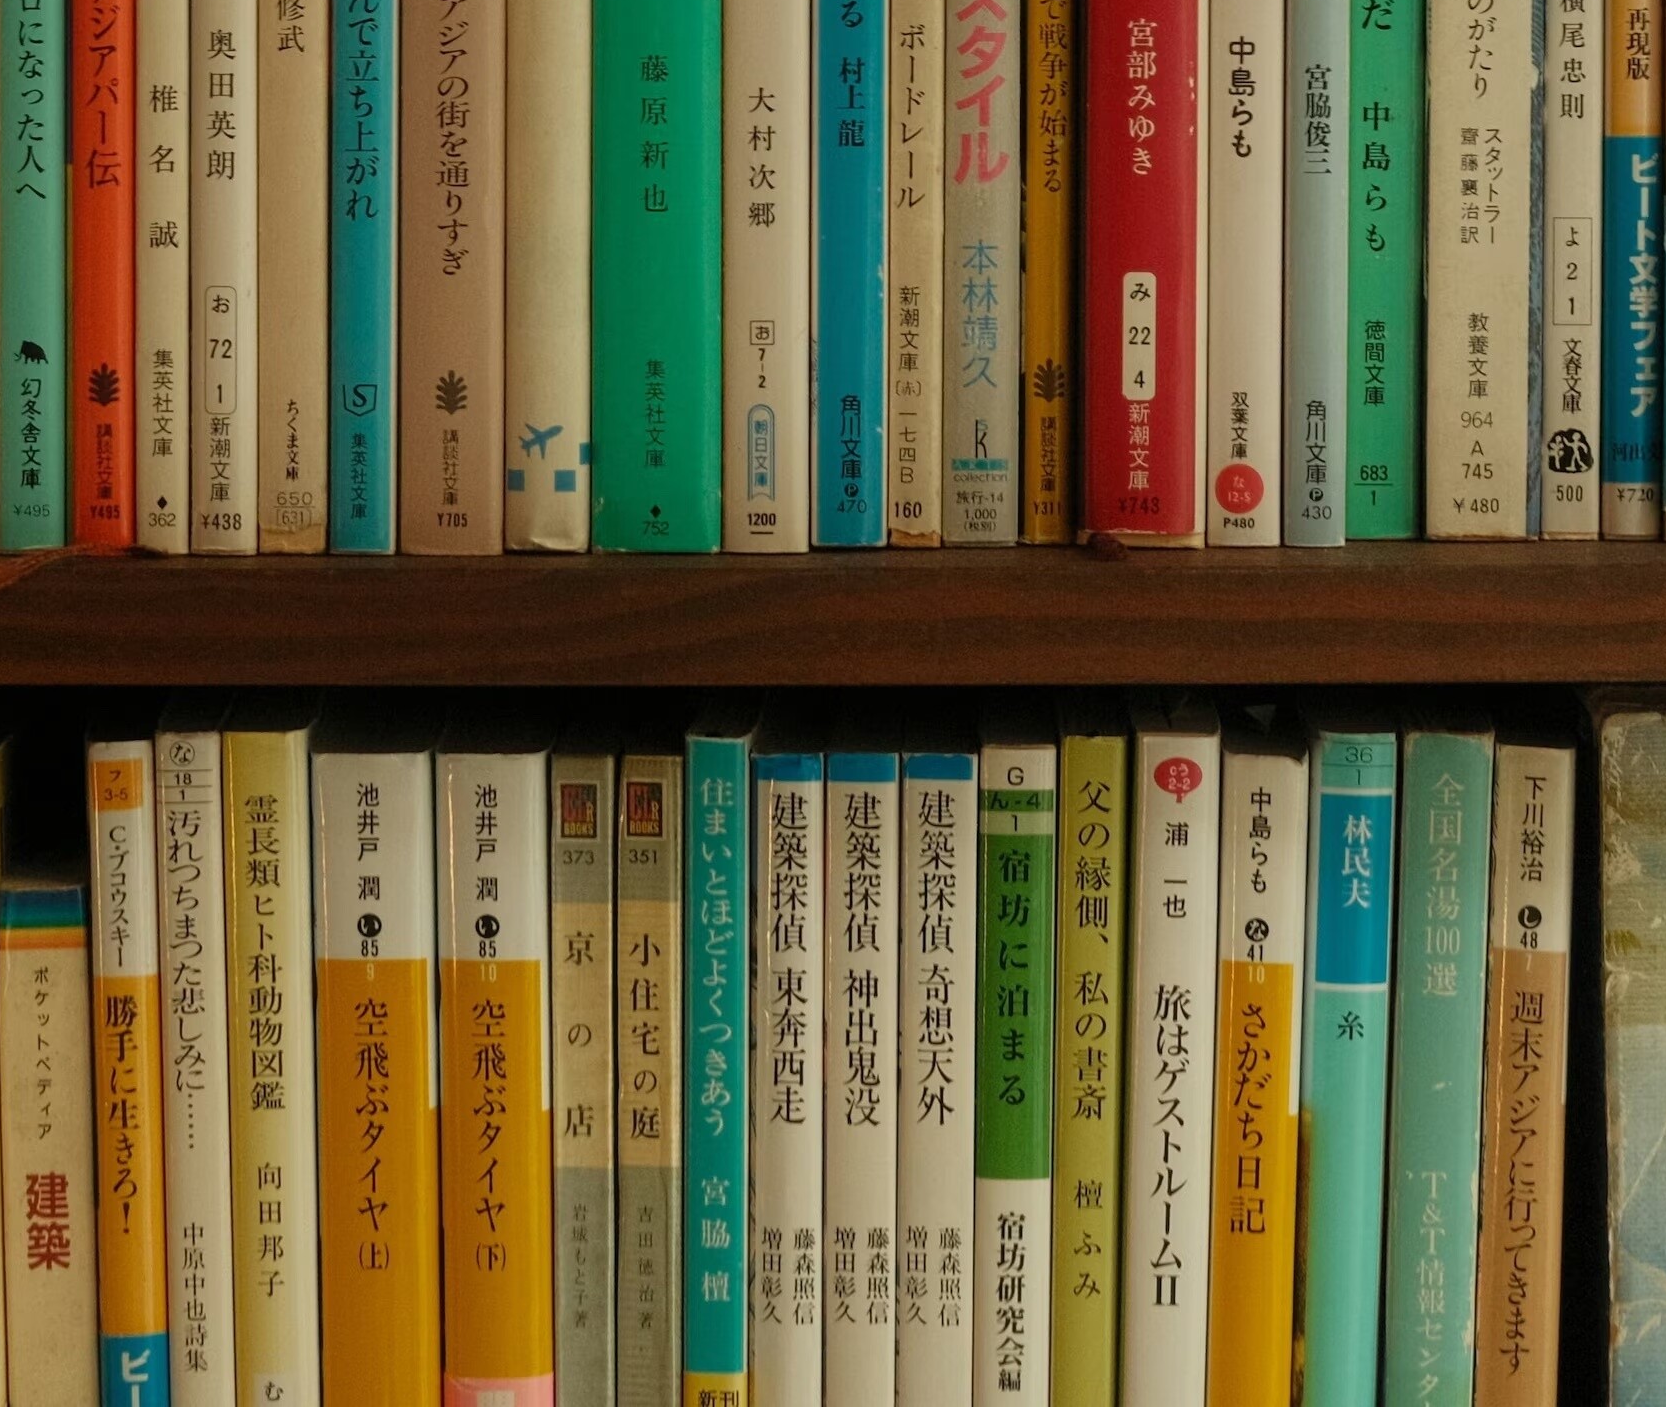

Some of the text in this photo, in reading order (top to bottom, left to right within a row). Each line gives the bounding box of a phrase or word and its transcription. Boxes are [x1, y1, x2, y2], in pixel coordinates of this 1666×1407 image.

[206, 28, 239, 182] 奥田英朗
[638, 53, 670, 214] 藤原新也
[1124, 18, 1160, 179] 宮部みゆき
[1628, 152, 1662, 419] ビート文学フェア
[1451, 496, 1501, 517] ¥480
[356, 781, 381, 903] 池井戸潤
[562, 846, 597, 868] 373
[1340, 813, 1375, 910] 林民夫
[243, 793, 288, 1114] 霊長類ヒト科動物図鑑
[628, 931, 662, 1140] 小住宅の庭
[698, 776, 736, 1140] 住まいとほどよくつきあう
[996, 848, 1032, 1109] 宿坊に泊まる
[1070, 779, 1113, 1122] 父の縁側、私の書斎
[33, 967, 52, 1142] ポケットペディア
[103, 993, 142, 1236] 勝手に生きろ！
[1229, 1002, 1274, 1236] さかだち日記
[25, 1171, 71, 1272] 建築
[1498, 989, 1546, 1377] 週末アジアに行ってきます
